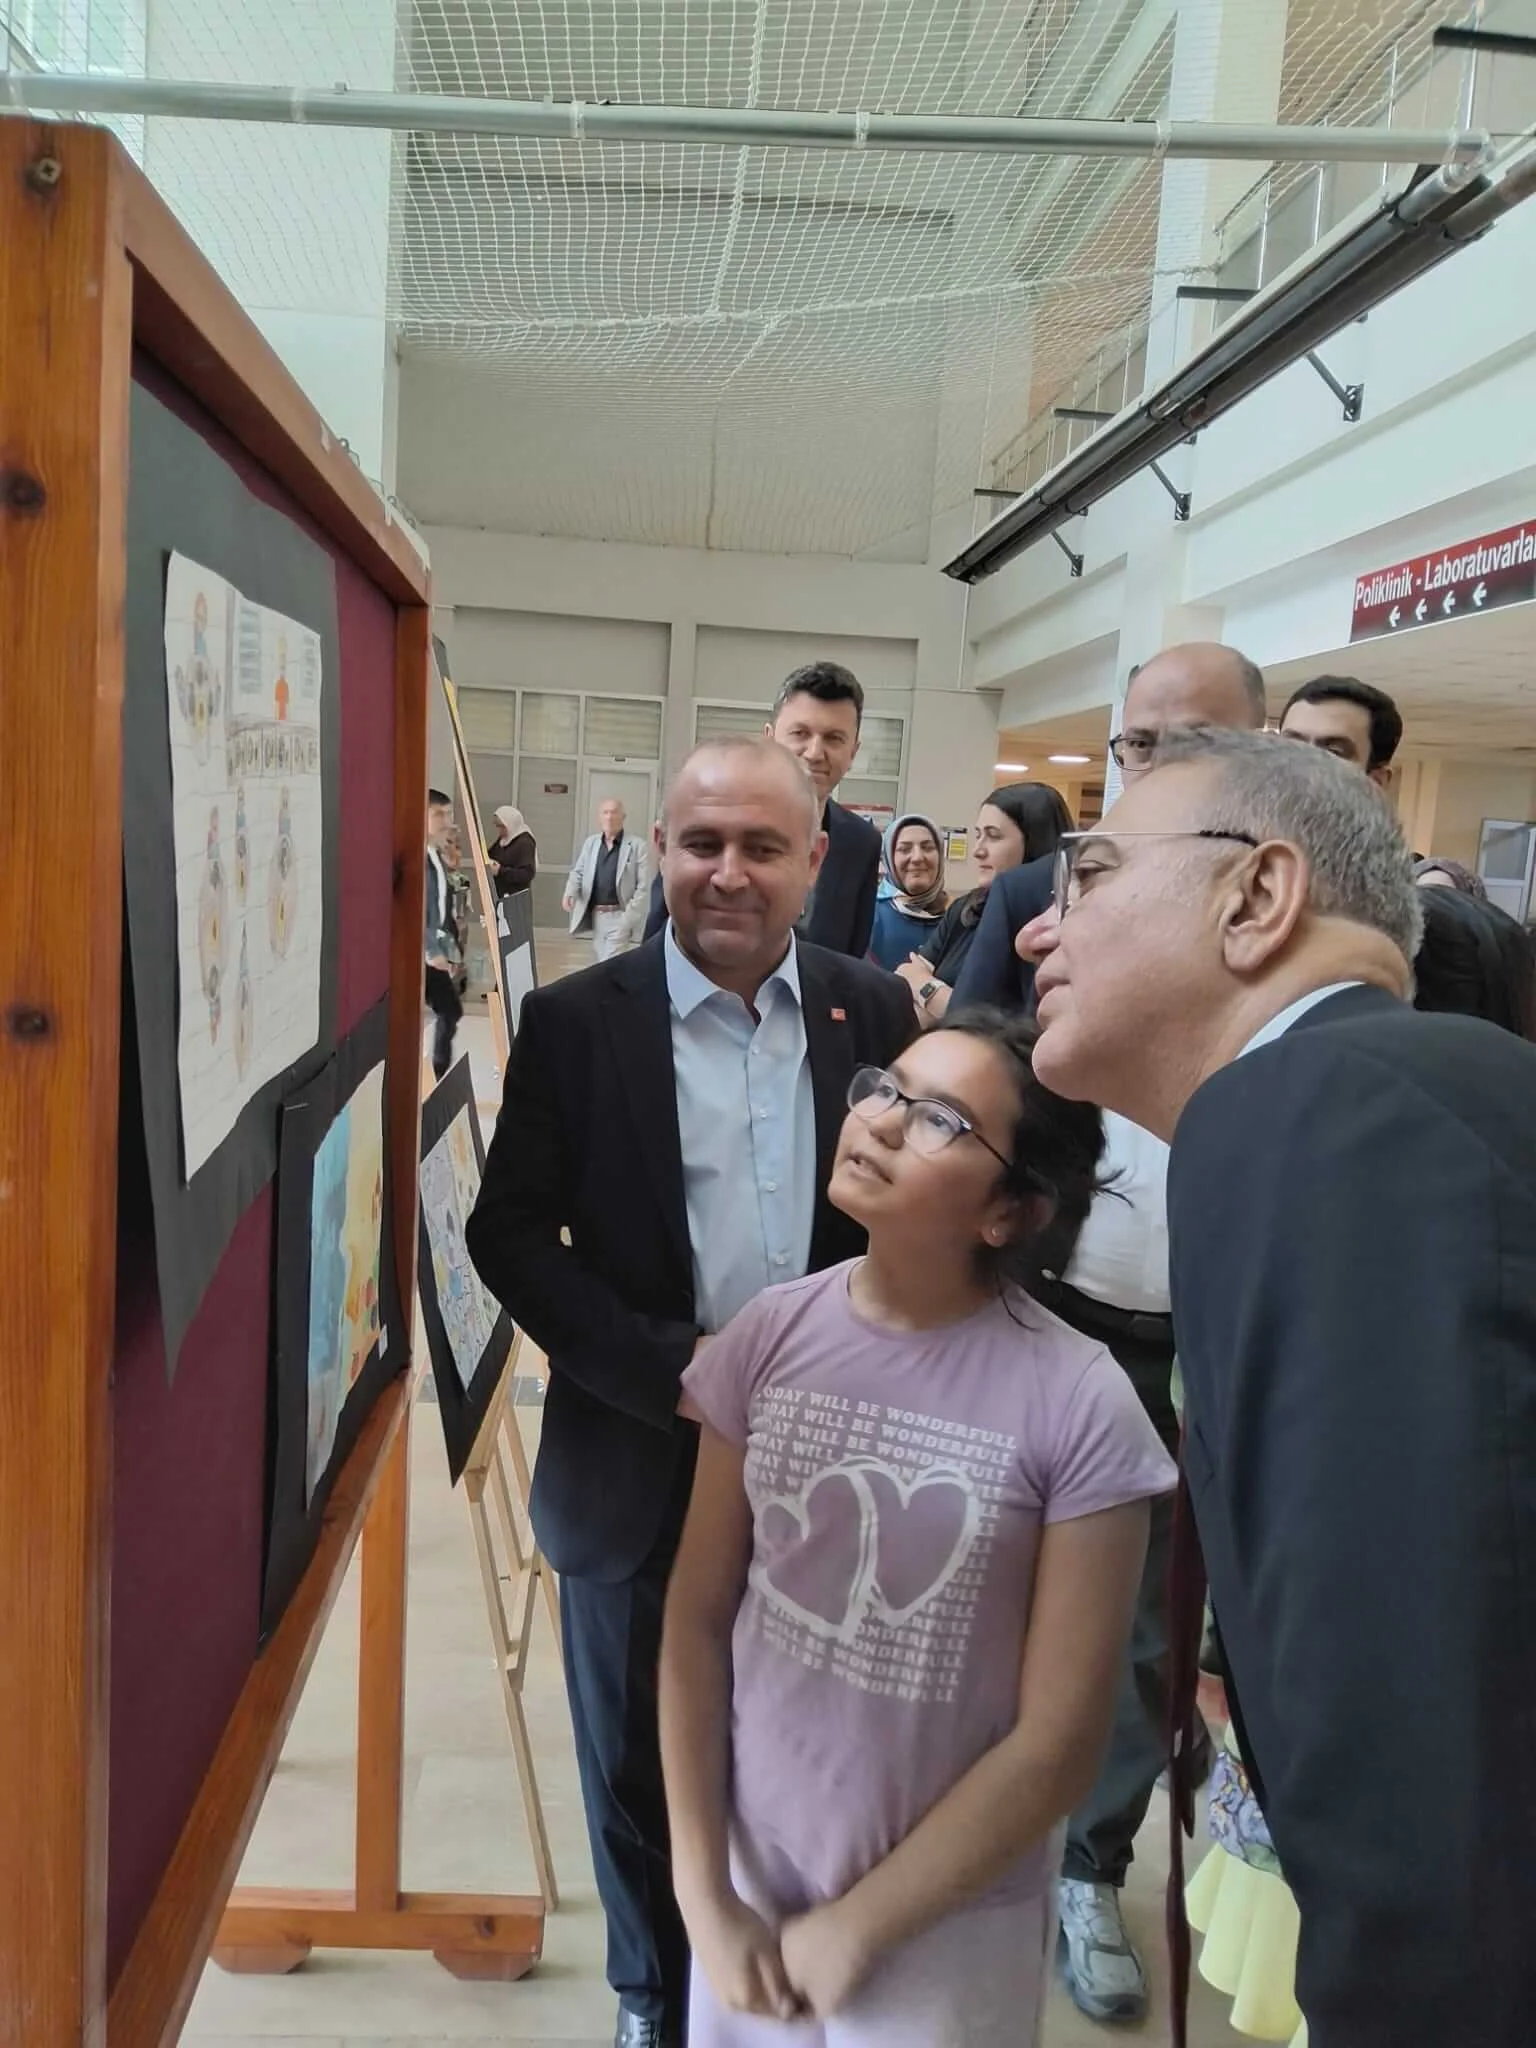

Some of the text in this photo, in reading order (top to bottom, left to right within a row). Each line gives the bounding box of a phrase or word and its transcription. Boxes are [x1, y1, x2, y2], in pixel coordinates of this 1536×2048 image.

[1354, 567, 1413, 611] Poliklinik
[1416, 578, 1422, 586] -
[755, 1384, 1017, 1450] ODAY WILL BE WONDERFULL
[798, 1424, 840, 1445] WILL
[847, 1434, 870, 1451] BE
[804, 1408, 846, 1429] WILL
[851, 1418, 875, 1434] BE
[881, 1423, 1012, 1466] WONDERFULL
